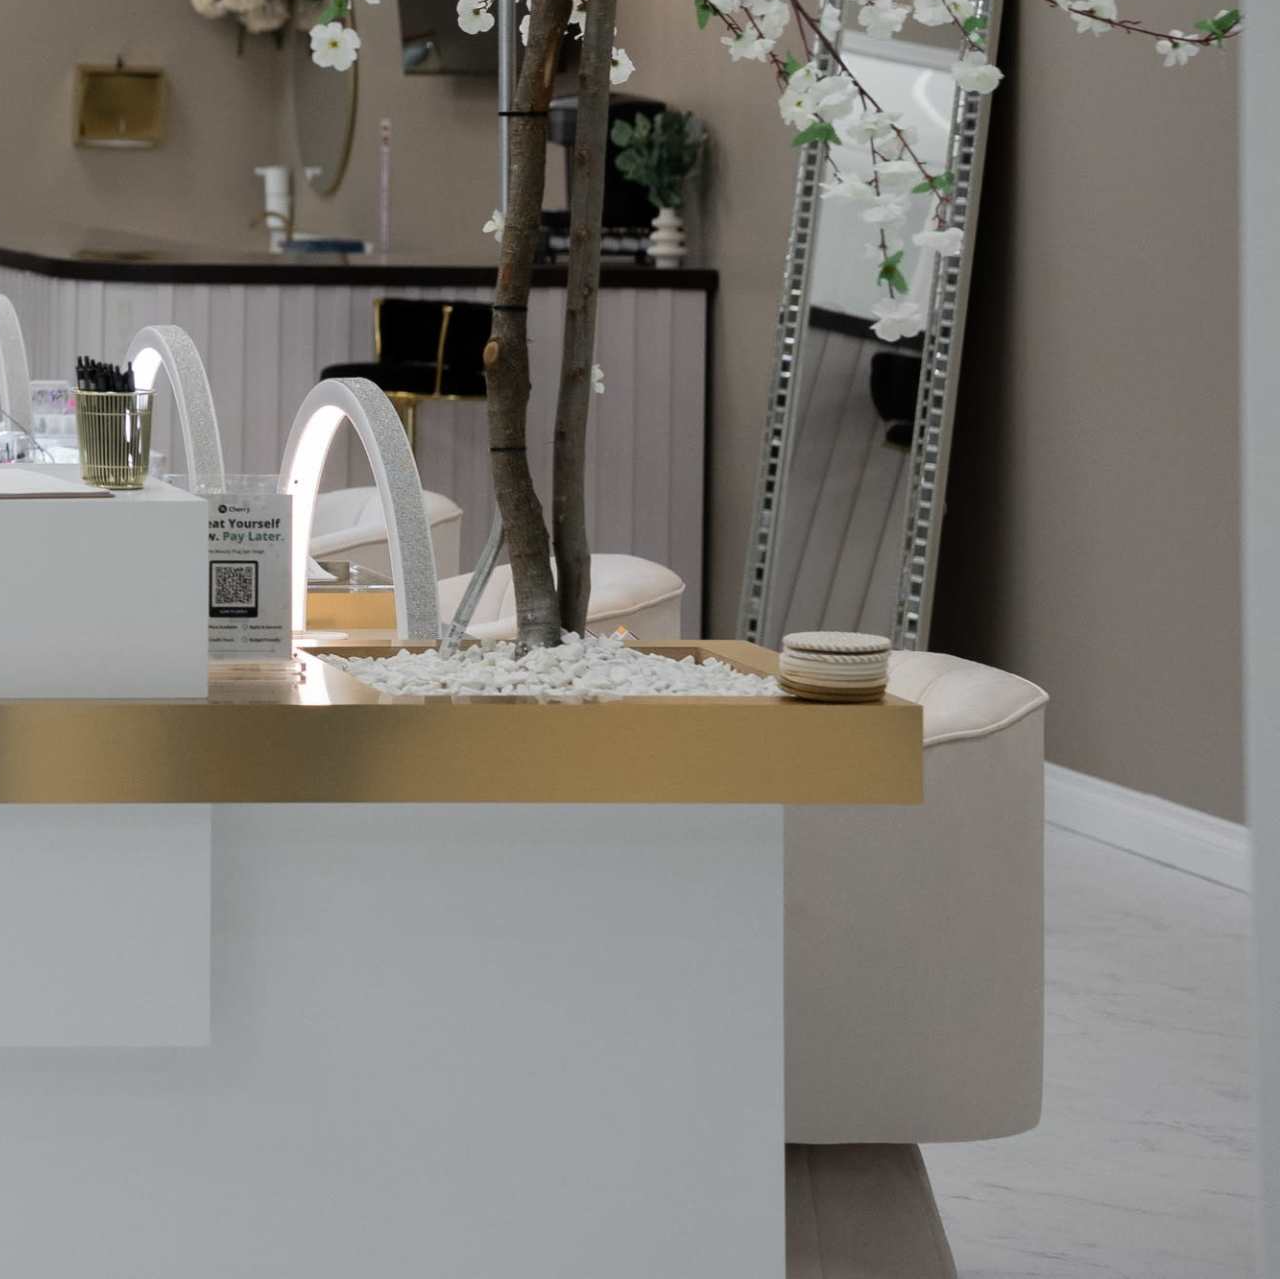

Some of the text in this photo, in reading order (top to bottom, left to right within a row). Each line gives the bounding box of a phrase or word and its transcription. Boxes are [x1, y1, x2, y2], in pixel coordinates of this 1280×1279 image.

[228, 505, 250, 514] Cherry
[228, 518, 281, 529] Yourself
[223, 531, 245, 544] Pay
[248, 531, 285, 542] Later.
